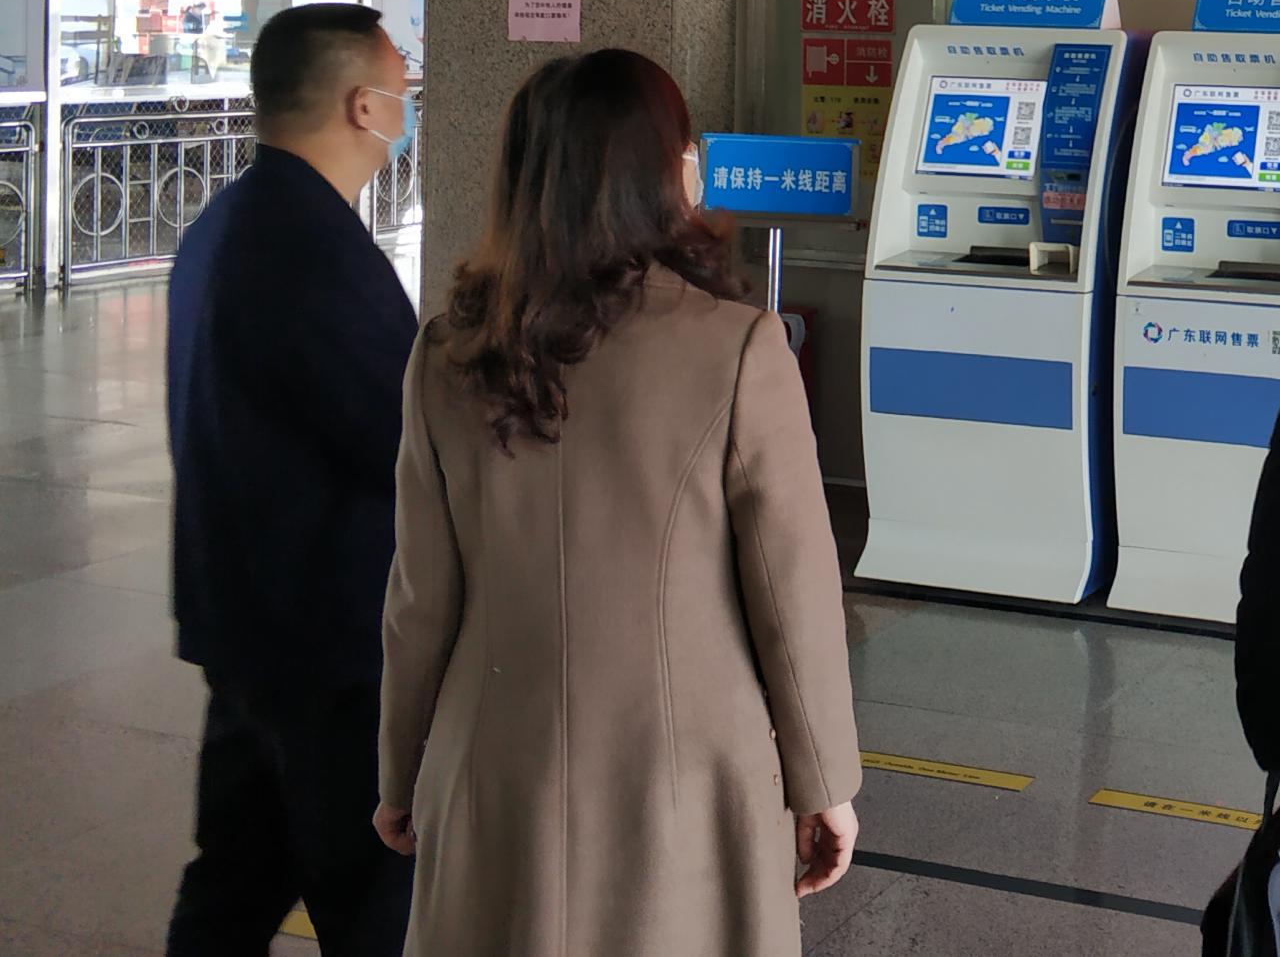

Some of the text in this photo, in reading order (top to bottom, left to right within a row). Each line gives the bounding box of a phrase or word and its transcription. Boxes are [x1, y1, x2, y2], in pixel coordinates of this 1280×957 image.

[980, 3, 1082, 16] Ticket Vending Machine
[1225, 8, 1251, 18] Ticket
[1193, 52, 1276, 65] 自助售取票机
[713, 165, 848, 194] 请保持一米线距离
[1168, 327, 1260, 348] 广东联网售票
